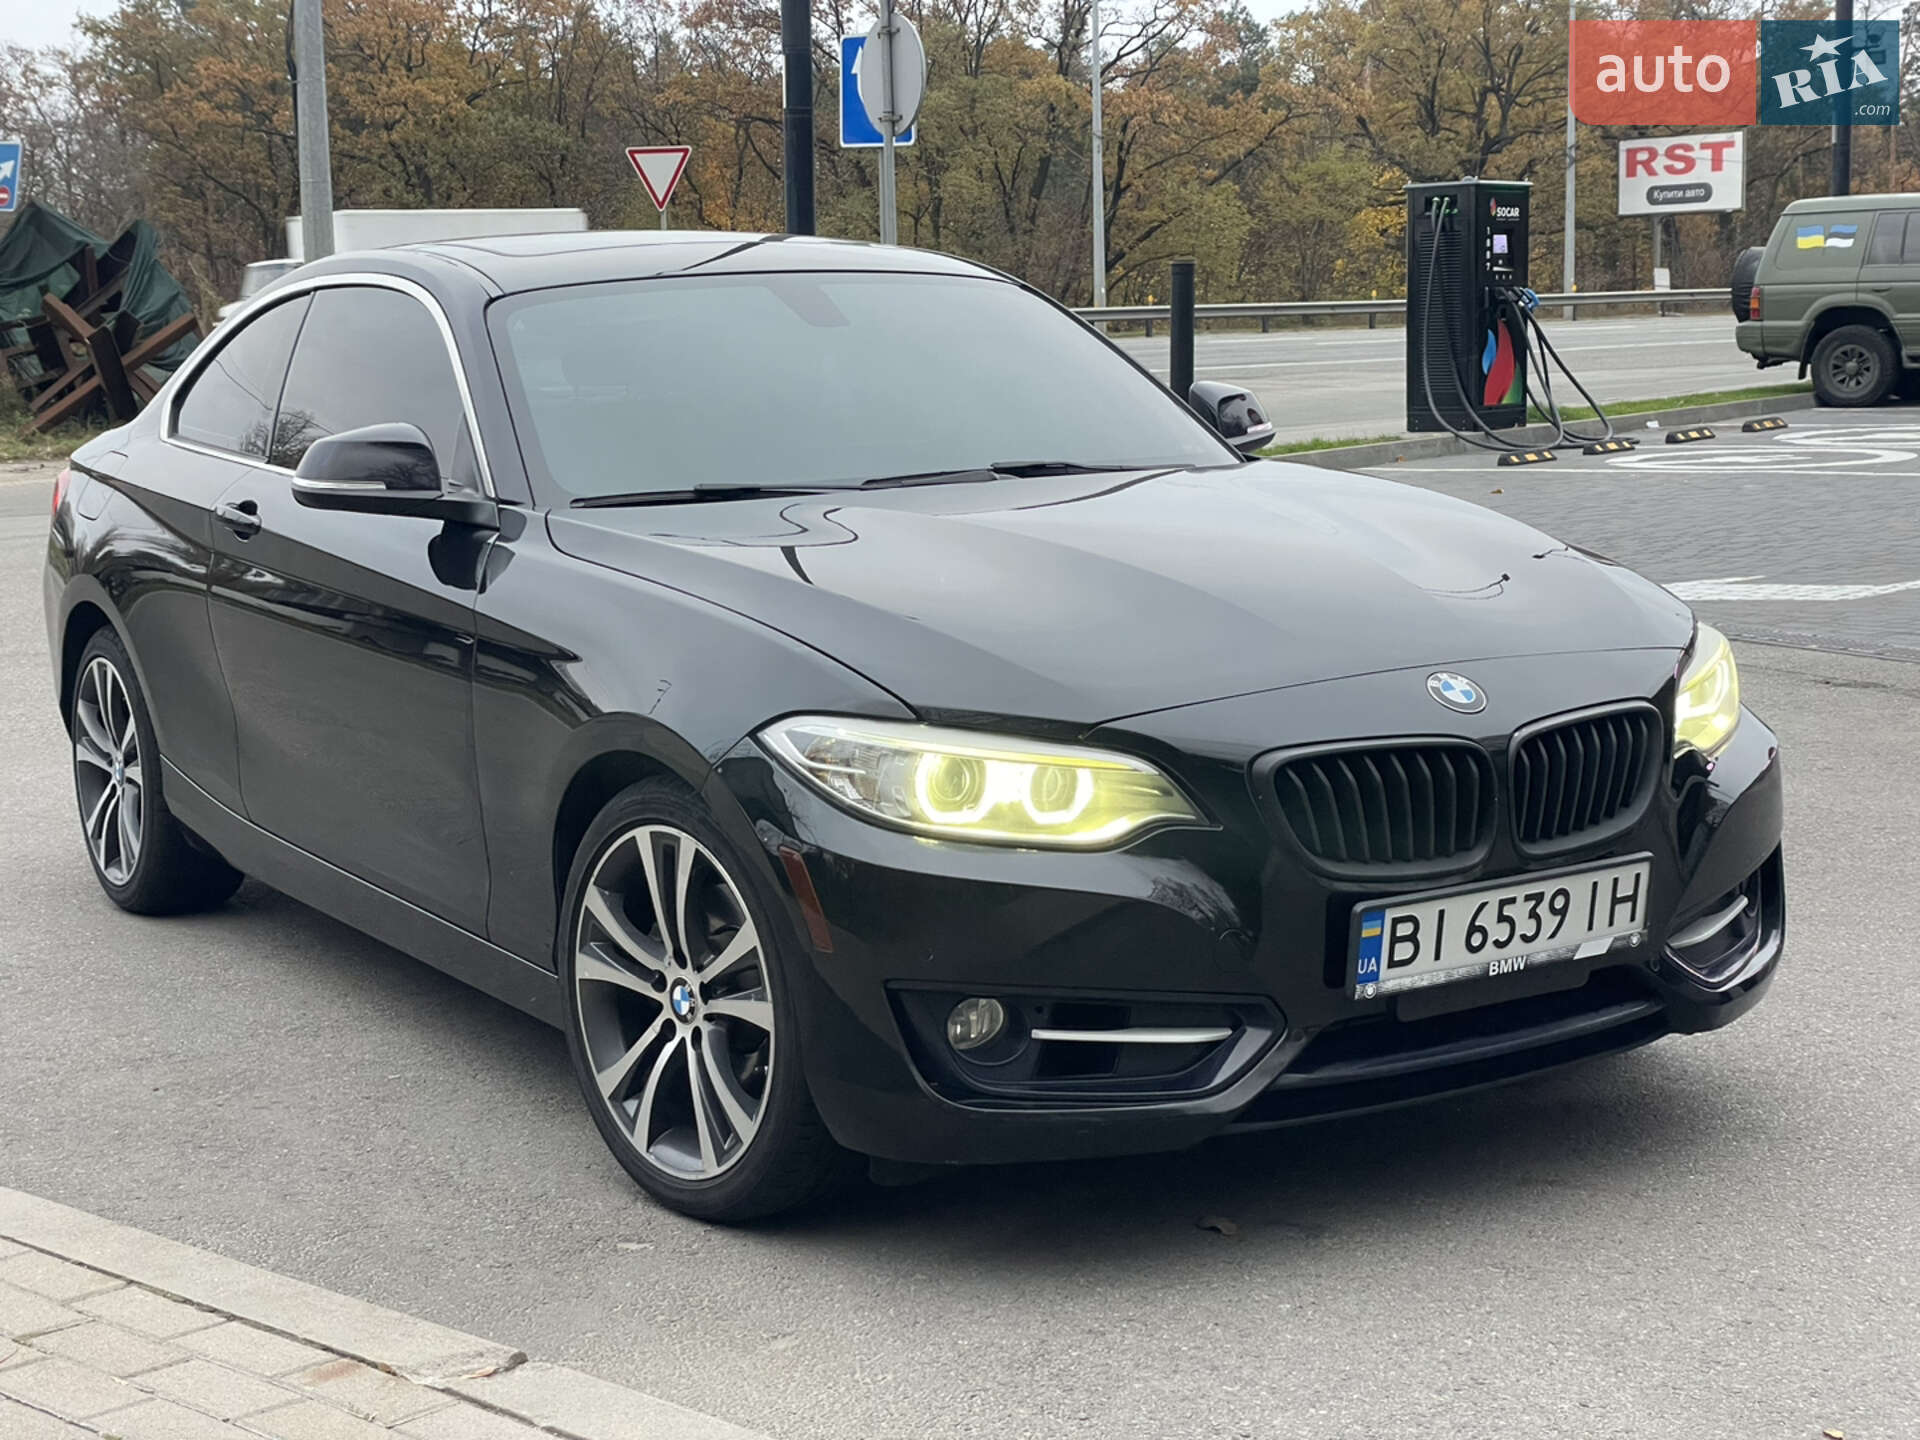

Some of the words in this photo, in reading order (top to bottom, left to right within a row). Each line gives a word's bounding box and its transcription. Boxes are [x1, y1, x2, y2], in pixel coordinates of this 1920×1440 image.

[1626, 140, 1735, 178] RST
[1653, 190, 1684, 201] Купити
[1685, 188, 1705, 198] авто
[1496, 207, 1520, 217] SOCAR
[1387, 908, 1445, 969] BI
[1465, 887, 1571, 954] 6539
[1586, 872, 1642, 932] IH
[1358, 958, 1378, 974] UA
[1488, 956, 1527, 977] BMW
